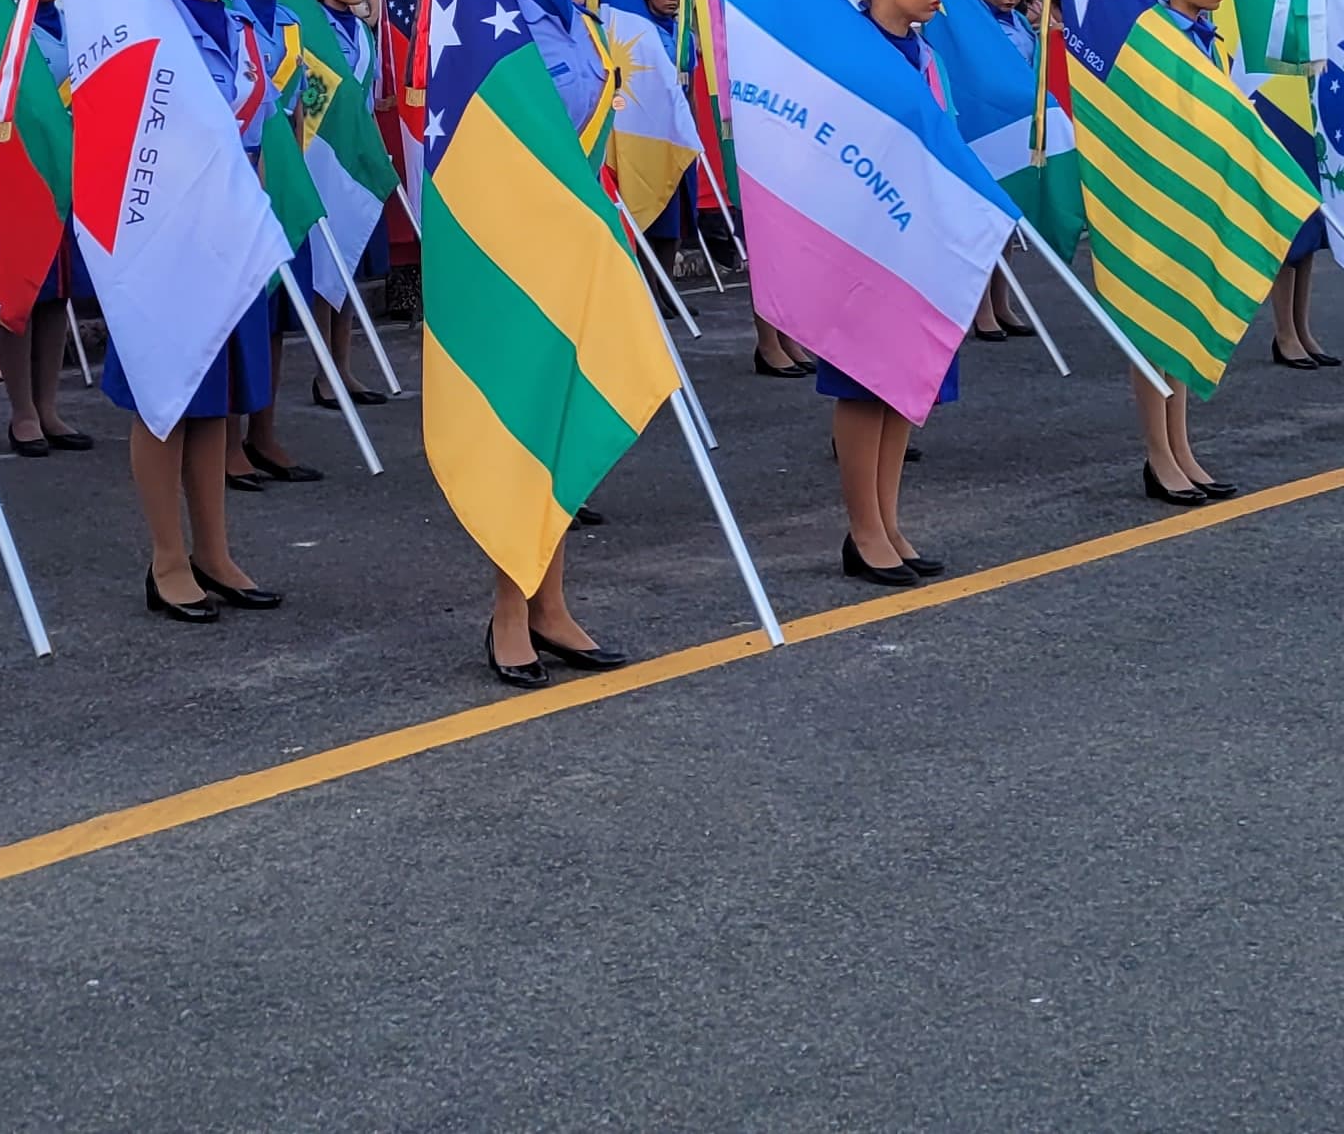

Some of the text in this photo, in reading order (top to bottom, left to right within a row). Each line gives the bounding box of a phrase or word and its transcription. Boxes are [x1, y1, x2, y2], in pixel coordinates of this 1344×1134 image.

[1068, 34, 1105, 72] DE 1823
[125, 147, 158, 226] SERA
[730, 80, 913, 232] ABALHA E CONFIA
